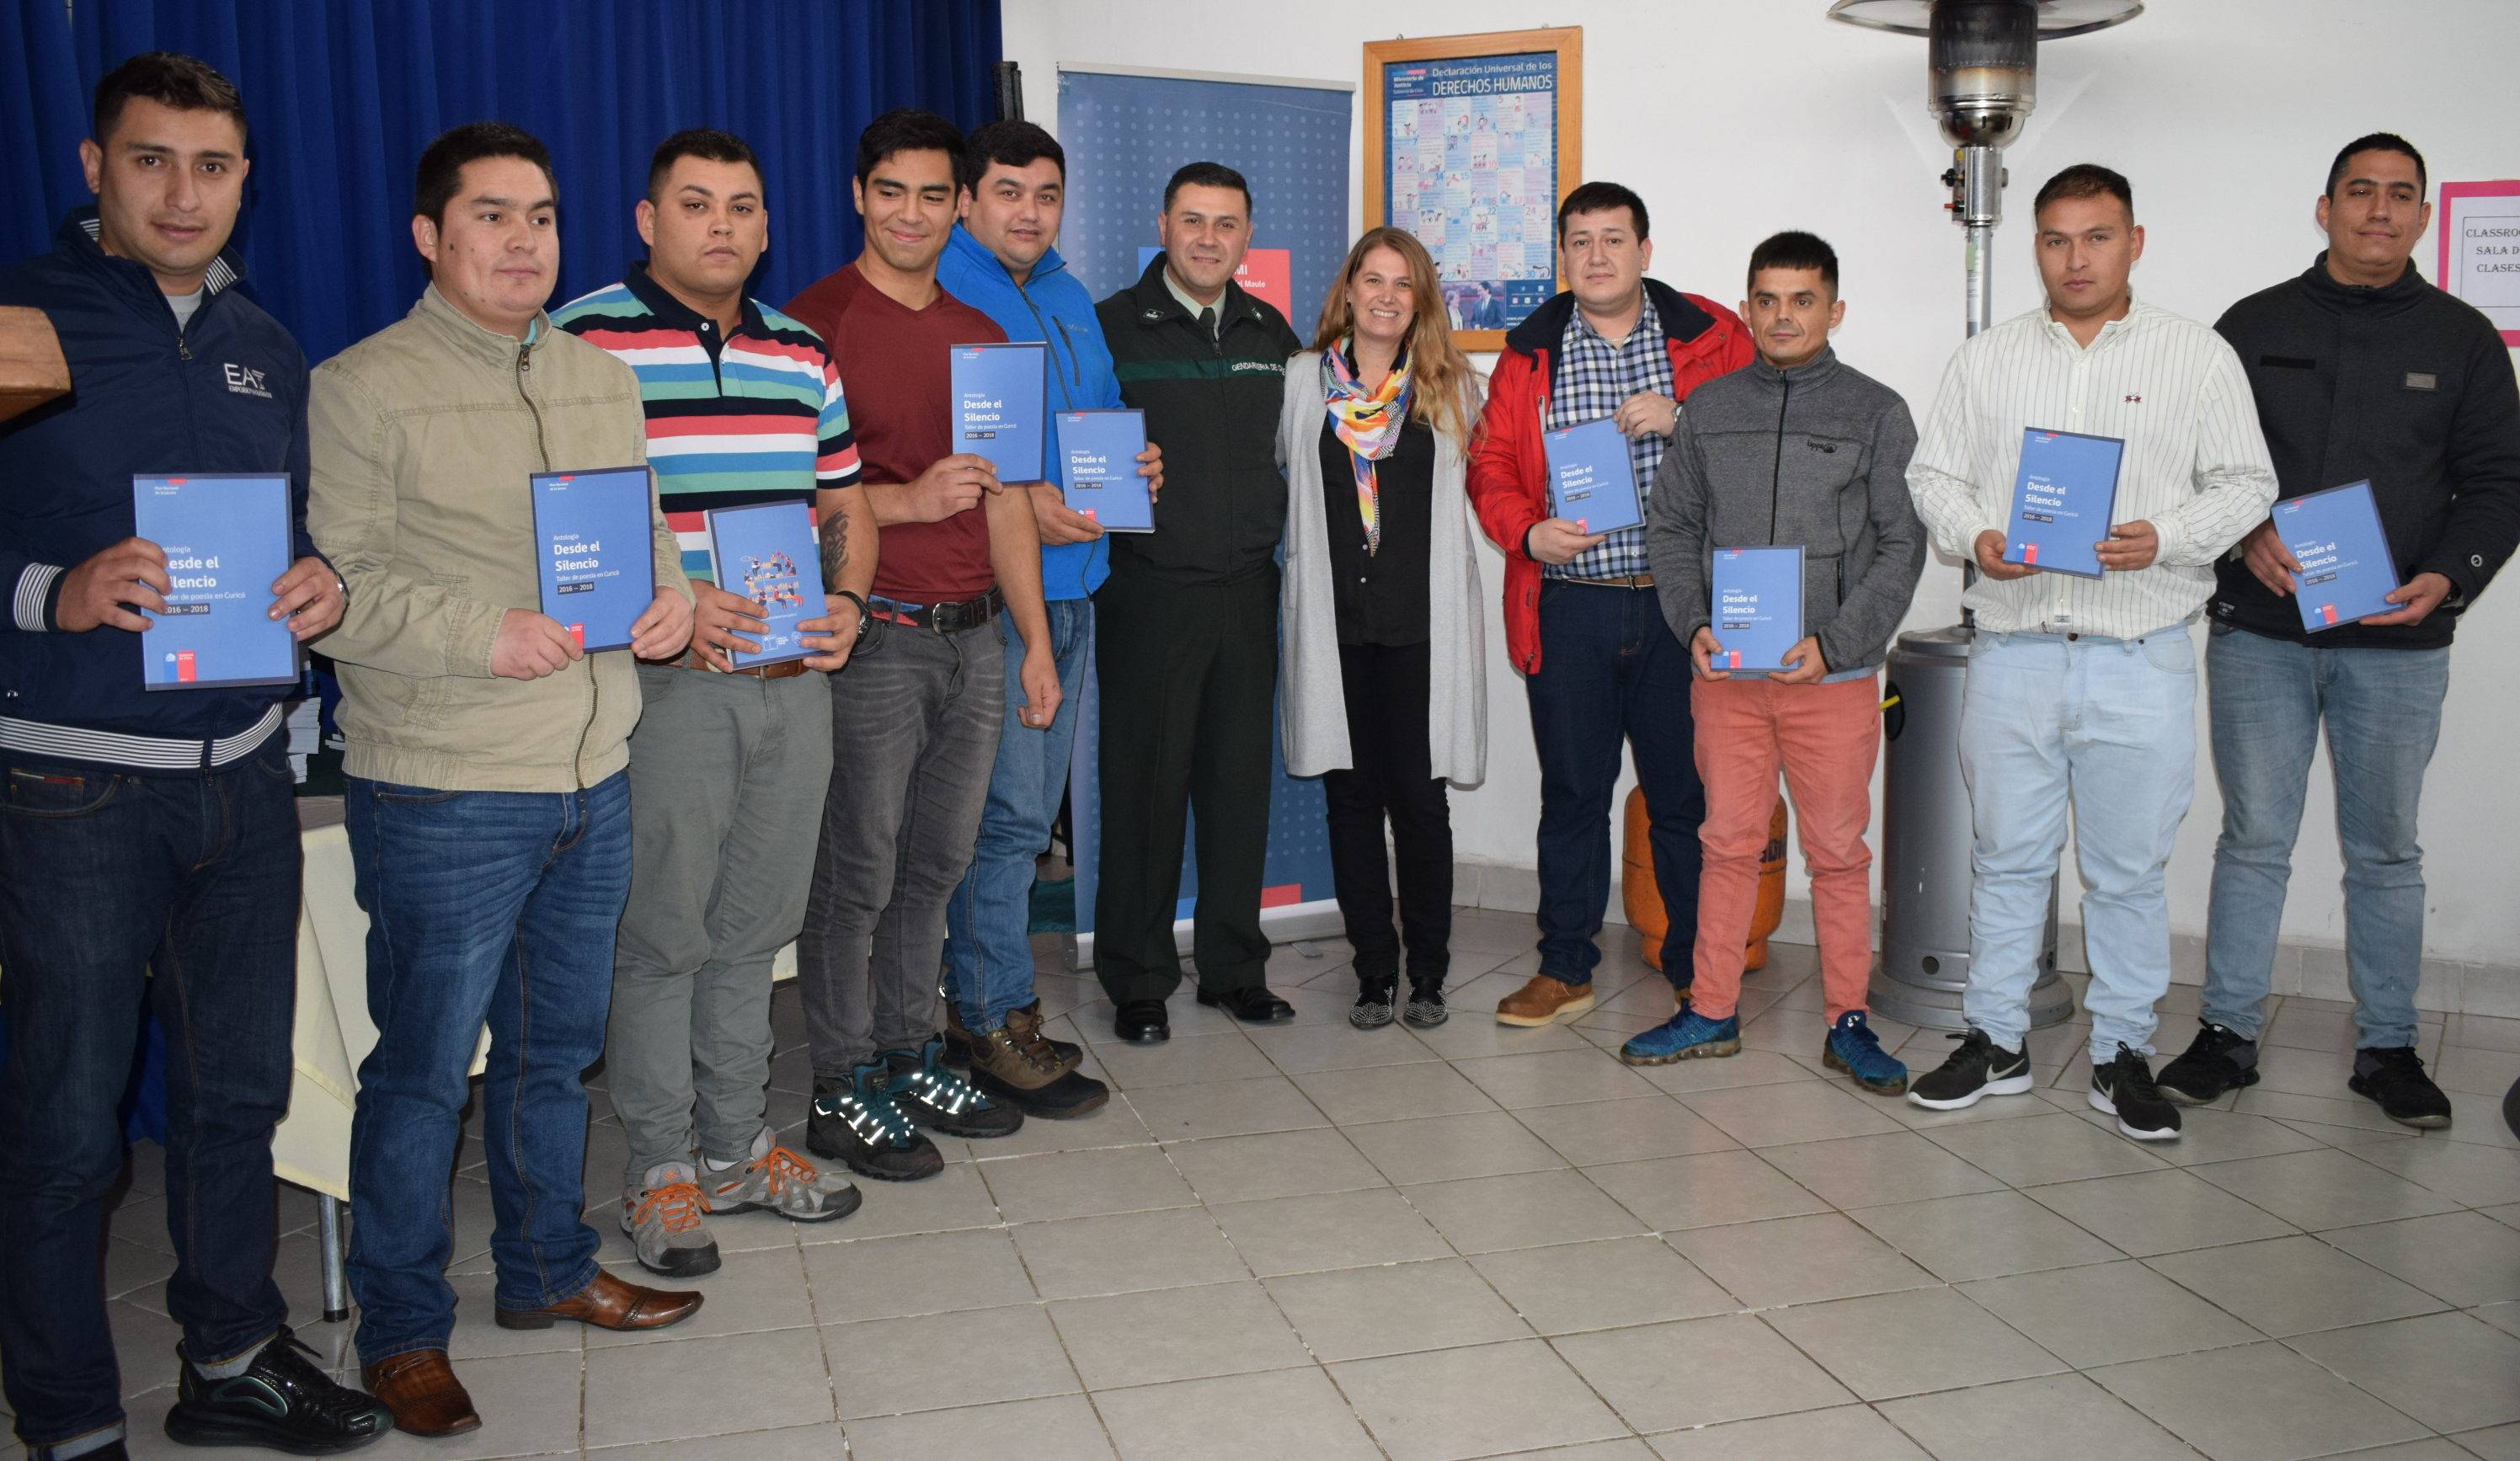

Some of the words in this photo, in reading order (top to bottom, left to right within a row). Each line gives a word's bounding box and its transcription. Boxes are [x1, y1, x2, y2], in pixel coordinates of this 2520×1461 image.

[1433, 66, 1482, 77] Declaración
[1484, 61, 1524, 73] Universal
[1526, 62, 1536, 71] de
[1539, 61, 1551, 70] los
[1433, 78, 1490, 95] DERECHOS
[1494, 75, 1552, 92] HUMANOS
[2466, 228, 2520, 237] CLASSRO
[2476, 247, 2507, 255] SALA
[2512, 247, 2520, 255] D
[1235, 264, 1248, 275] MI
[2477, 264, 2520, 273] CLASES
[224, 363, 265, 390] EA7
[964, 400, 992, 408] Desde
[994, 400, 1002, 408] el
[964, 413, 1000, 421] Silencio
[1072, 466, 1106, 474] Silencio
[1561, 468, 1583, 478] Desde
[1563, 476, 1593, 488] Silencio
[2027, 482, 2054, 493] Desde
[2025, 494, 2061, 506] Silencio
[554, 542, 587, 555] Desde
[590, 541, 600, 552] el
[2297, 546, 2325, 558] Desde
[2326, 542, 2336, 551] el
[169, 557, 202, 569] esde
[206, 556, 219, 568] el
[556, 558, 599, 572] Silencio
[2300, 555, 2336, 569] Silencio
[169, 575, 216, 588] ilencio
[1722, 595, 1748, 603] Desde
